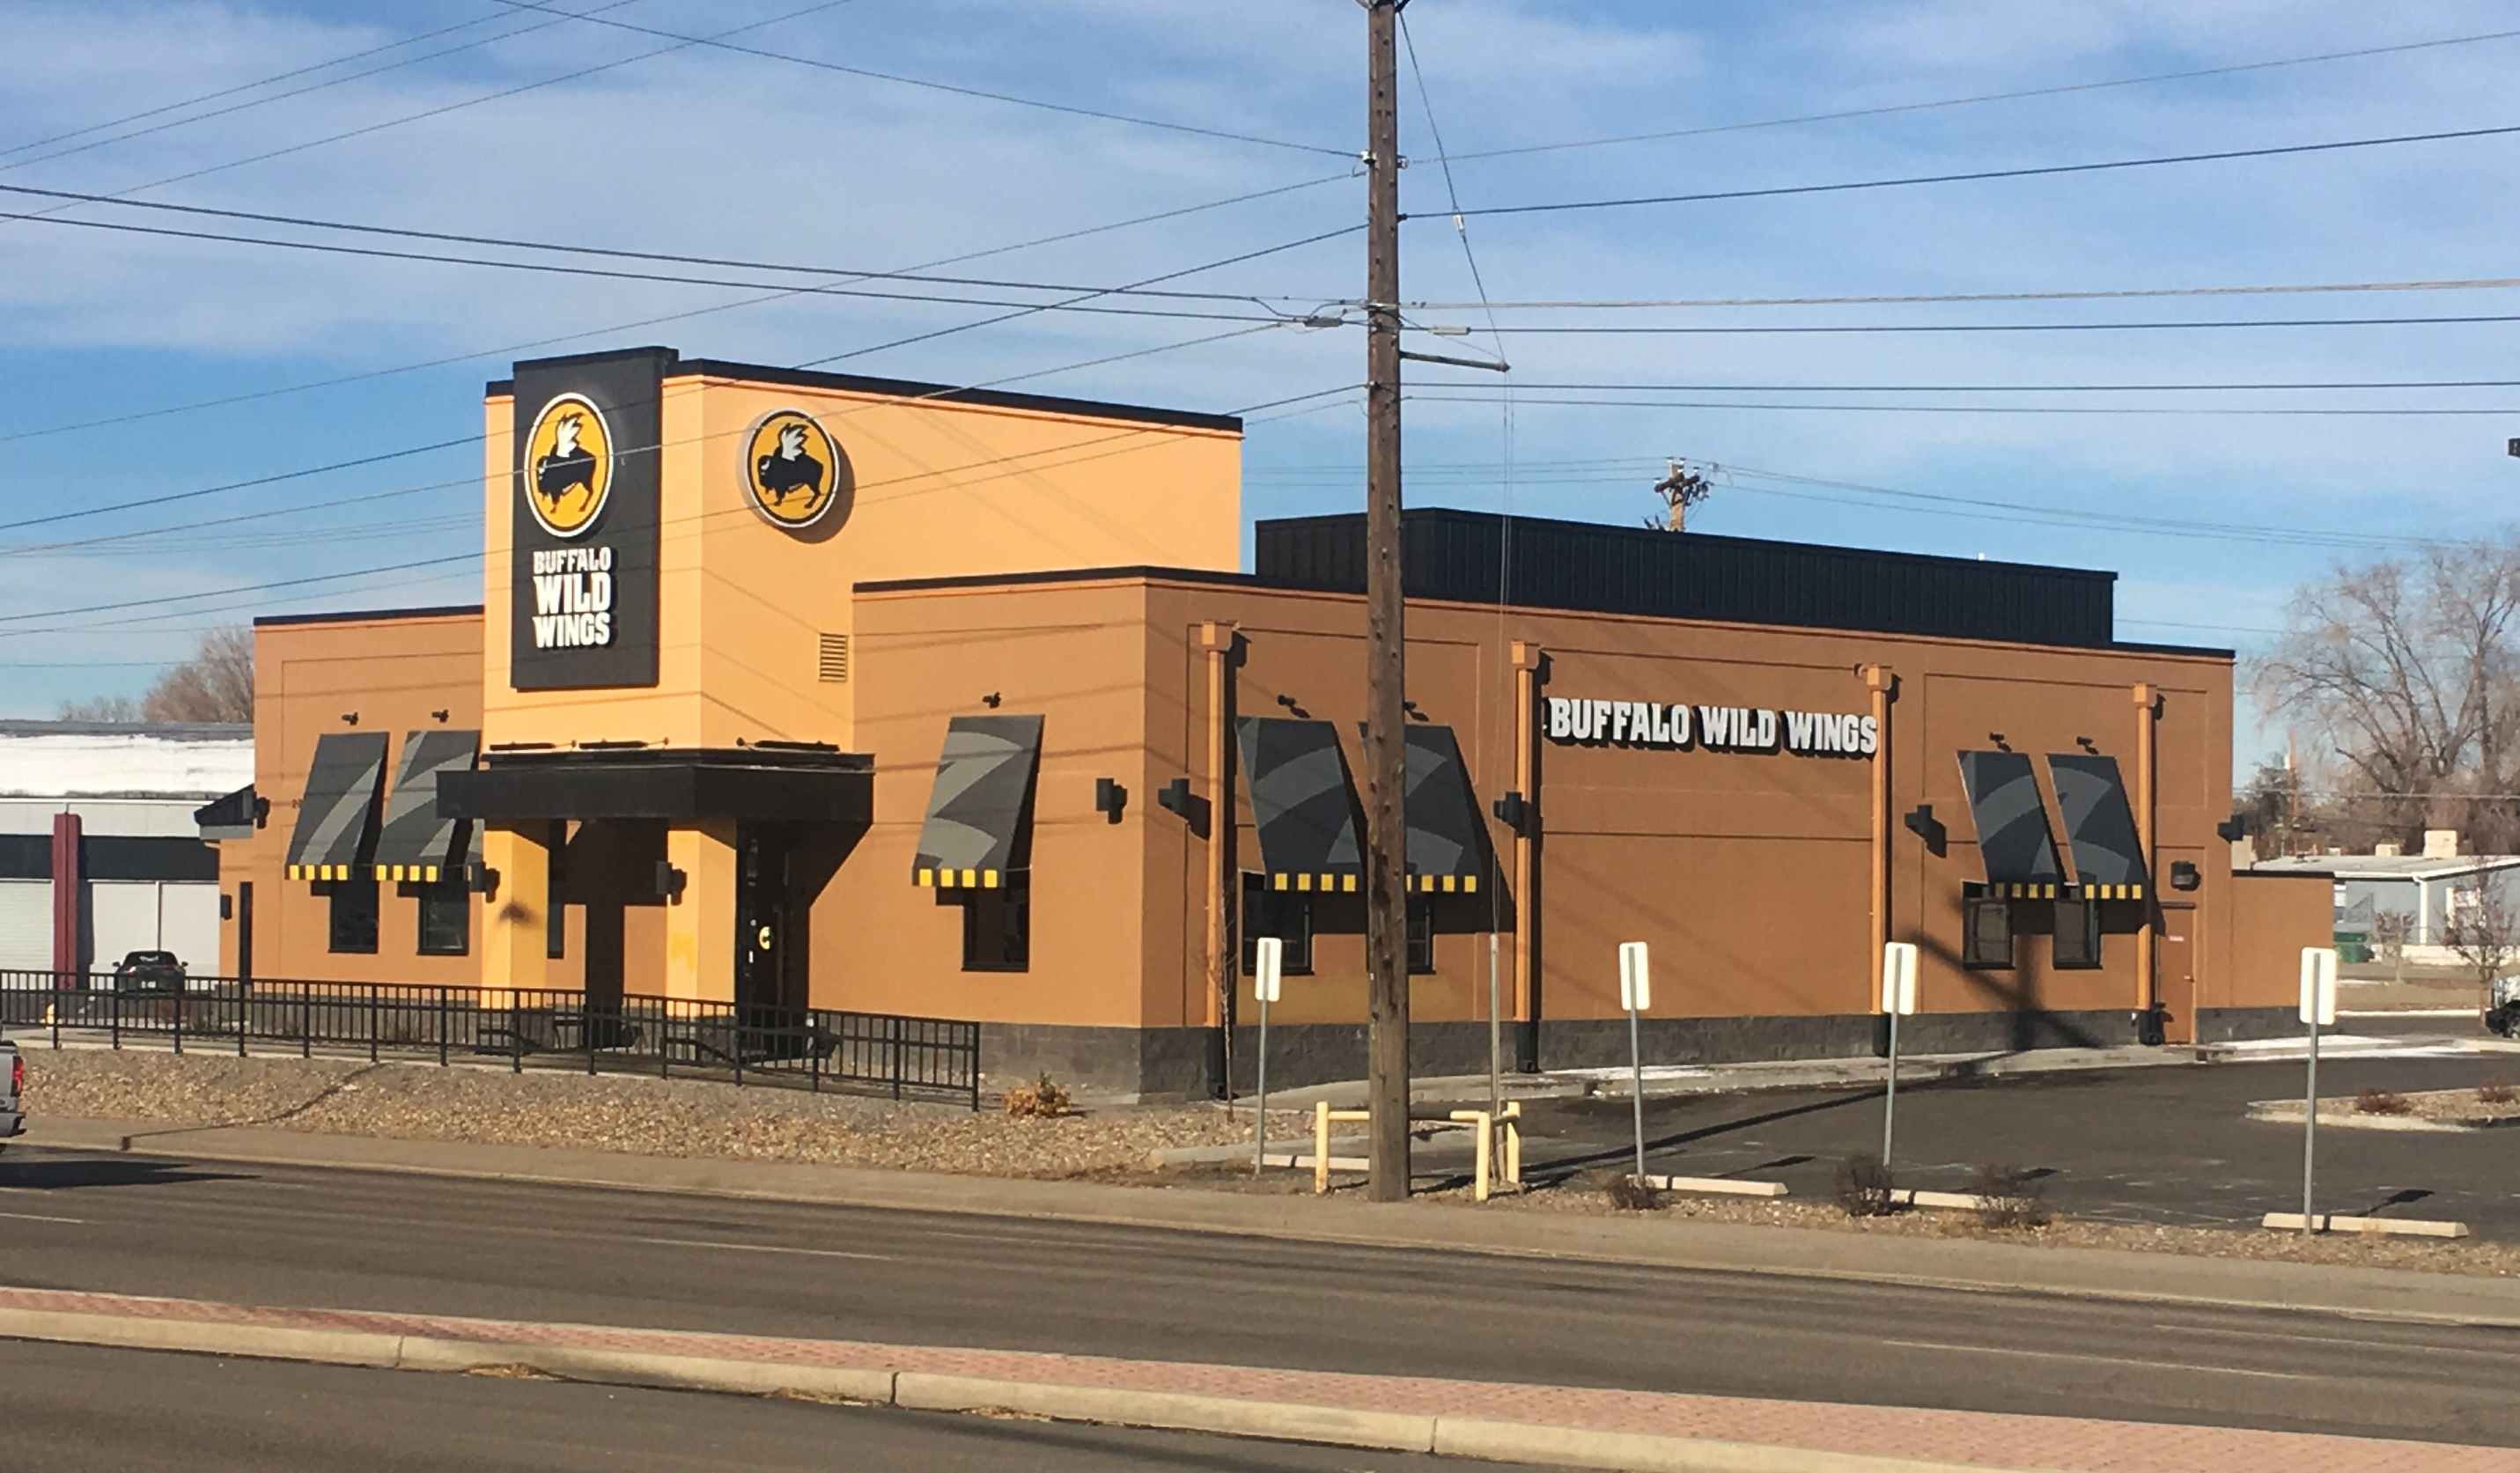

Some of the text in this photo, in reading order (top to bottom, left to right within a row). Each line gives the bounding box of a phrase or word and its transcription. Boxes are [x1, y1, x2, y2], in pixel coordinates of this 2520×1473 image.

[533, 547, 611, 574] BUFFALO
[533, 572, 611, 615] WILD
[532, 612, 610, 648] WINGS
[1548, 697, 1877, 754] BUFFALO WILD WINGS
